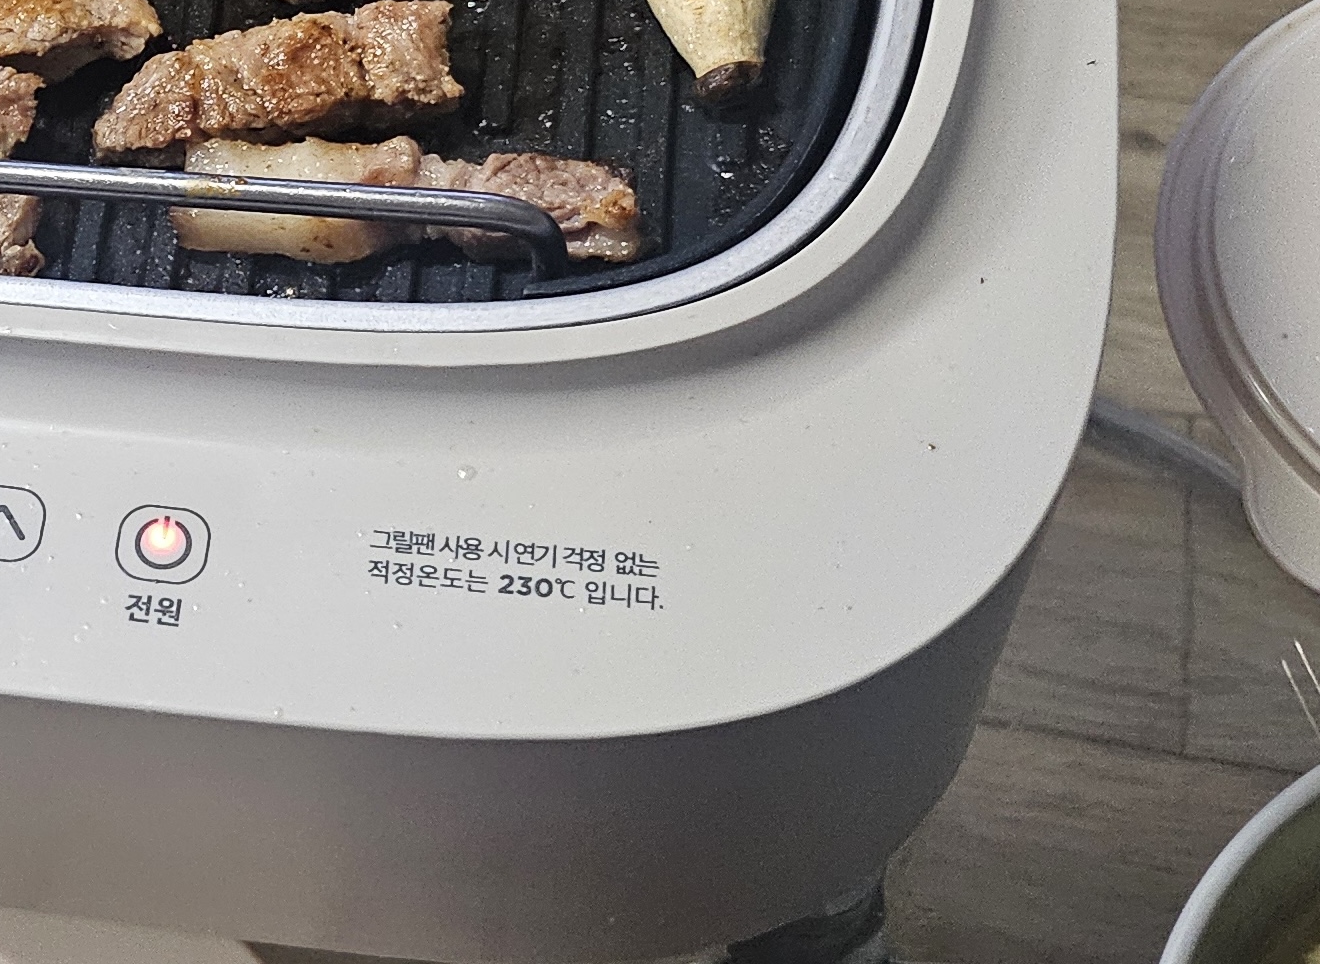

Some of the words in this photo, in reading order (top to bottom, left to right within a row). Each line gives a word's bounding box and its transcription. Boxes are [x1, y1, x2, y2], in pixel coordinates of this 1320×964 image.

[370, 529, 436, 556] 그릴팬
[439, 536, 484, 561] 사용
[487, 540, 510, 565] 시
[514, 541, 557, 569] 연기
[562, 546, 606, 573] 걱정
[614, 550, 660, 579] 없는
[368, 559, 489, 594] 적정온도는
[584, 580, 664, 611] 입니다.
[123, 593, 183, 628] 전원
